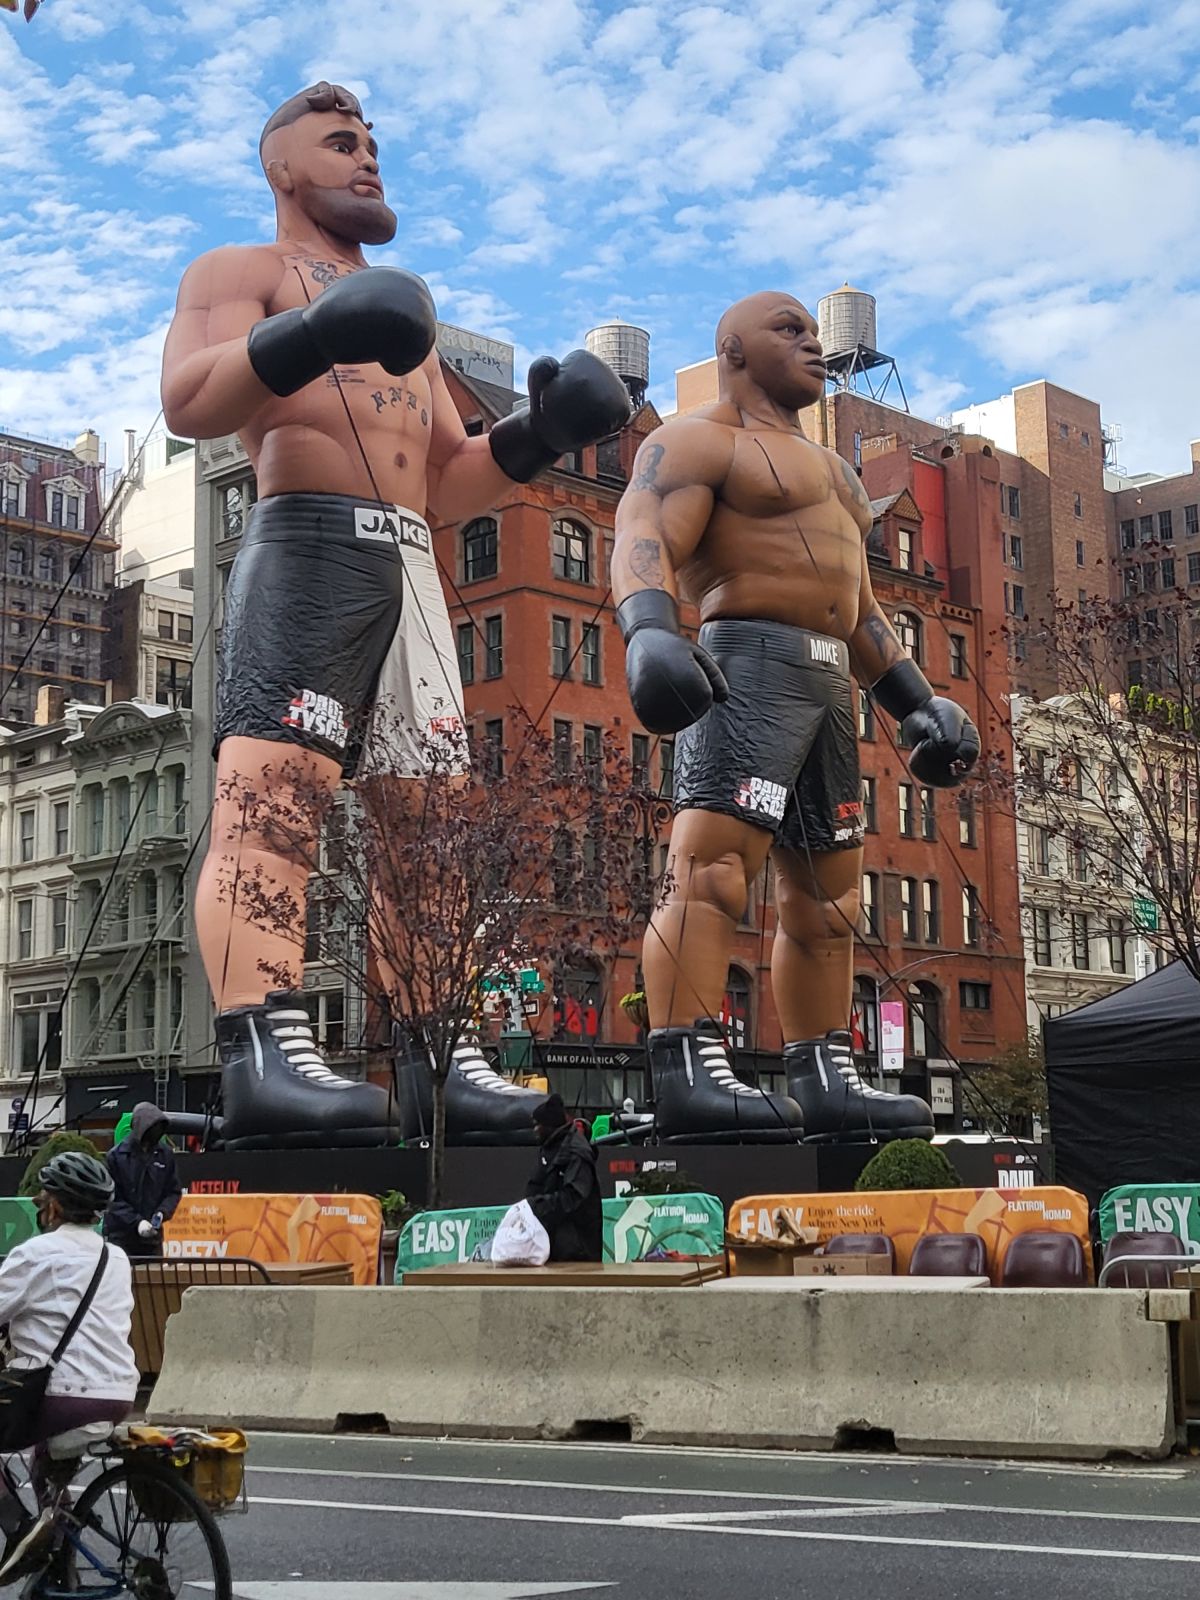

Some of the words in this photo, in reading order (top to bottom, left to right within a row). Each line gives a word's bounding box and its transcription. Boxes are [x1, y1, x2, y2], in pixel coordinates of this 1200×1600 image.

[361, 515, 428, 549] JAKE
[810, 638, 839, 666] MIKE
[547, 1054, 569, 1064] BANK
[569, 1055, 580, 1064] OF
[321, 1206, 350, 1217] FLATIRON
[654, 1205, 686, 1217] FLATIRON
[808, 1207, 834, 1219] Enjoy
[836, 1204, 853, 1217] the
[1007, 1200, 1045, 1213] FLATIRON
[683, 1212, 710, 1225] NOMAD
[1042, 1208, 1072, 1221] NOMAD
[1114, 1196, 1193, 1241] EASY
[808, 1219, 838, 1229] where
[839, 1218, 860, 1228] New
[862, 1215, 886, 1228] York
[412, 1218, 471, 1263] EASY
